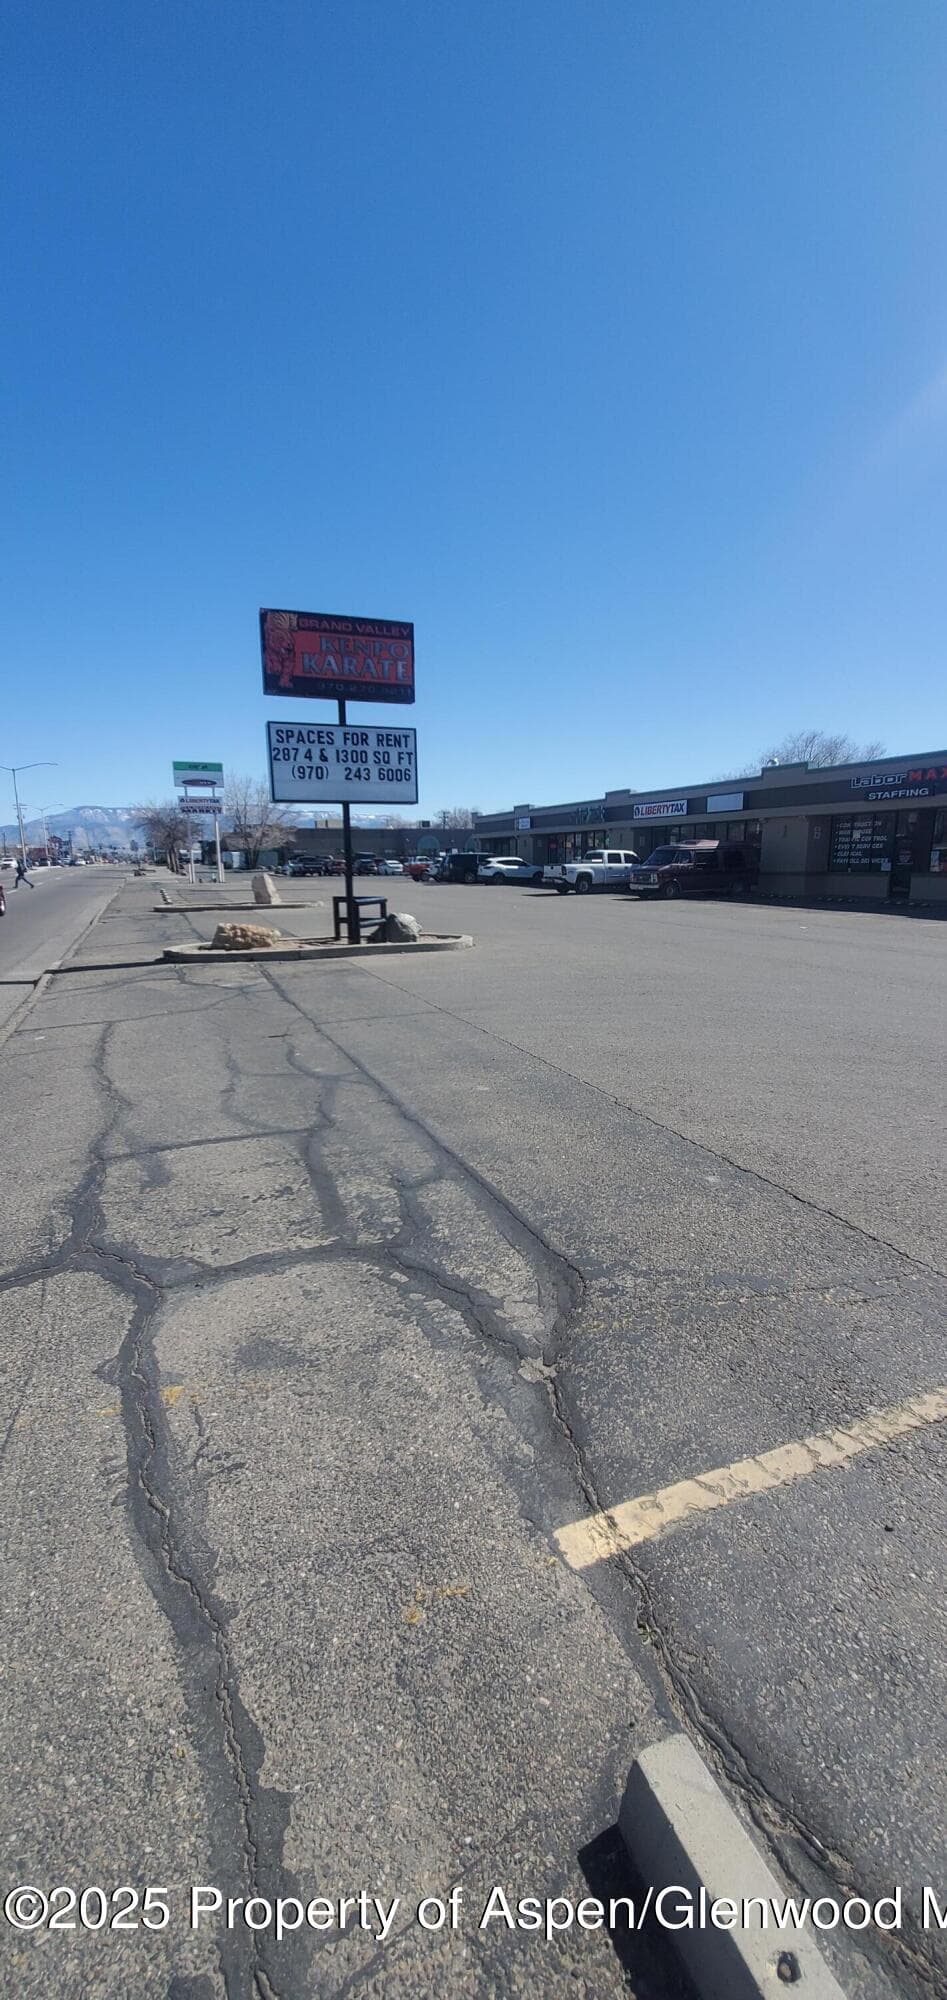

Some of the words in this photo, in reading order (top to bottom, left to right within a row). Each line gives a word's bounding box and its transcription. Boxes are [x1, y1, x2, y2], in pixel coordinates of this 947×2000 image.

[298, 617, 353, 631] GRAND
[356, 624, 410, 637] VALLEY
[319, 635, 410, 659] KENPO
[302, 652, 410, 681] KARATE
[276, 729, 334, 745] SPACES
[343, 732, 369, 746] FOR
[376, 733, 410, 748] RENT
[319, 748, 329, 762] &
[336, 750, 368, 764] 1300
[373, 751, 390, 765] SQ
[398, 752, 414, 765] FT
[291, 765, 329, 780] (970)
[344, 767, 370, 781] 243
[378, 768, 411, 782] 6006
[868, 787, 929, 800] STAFFING
